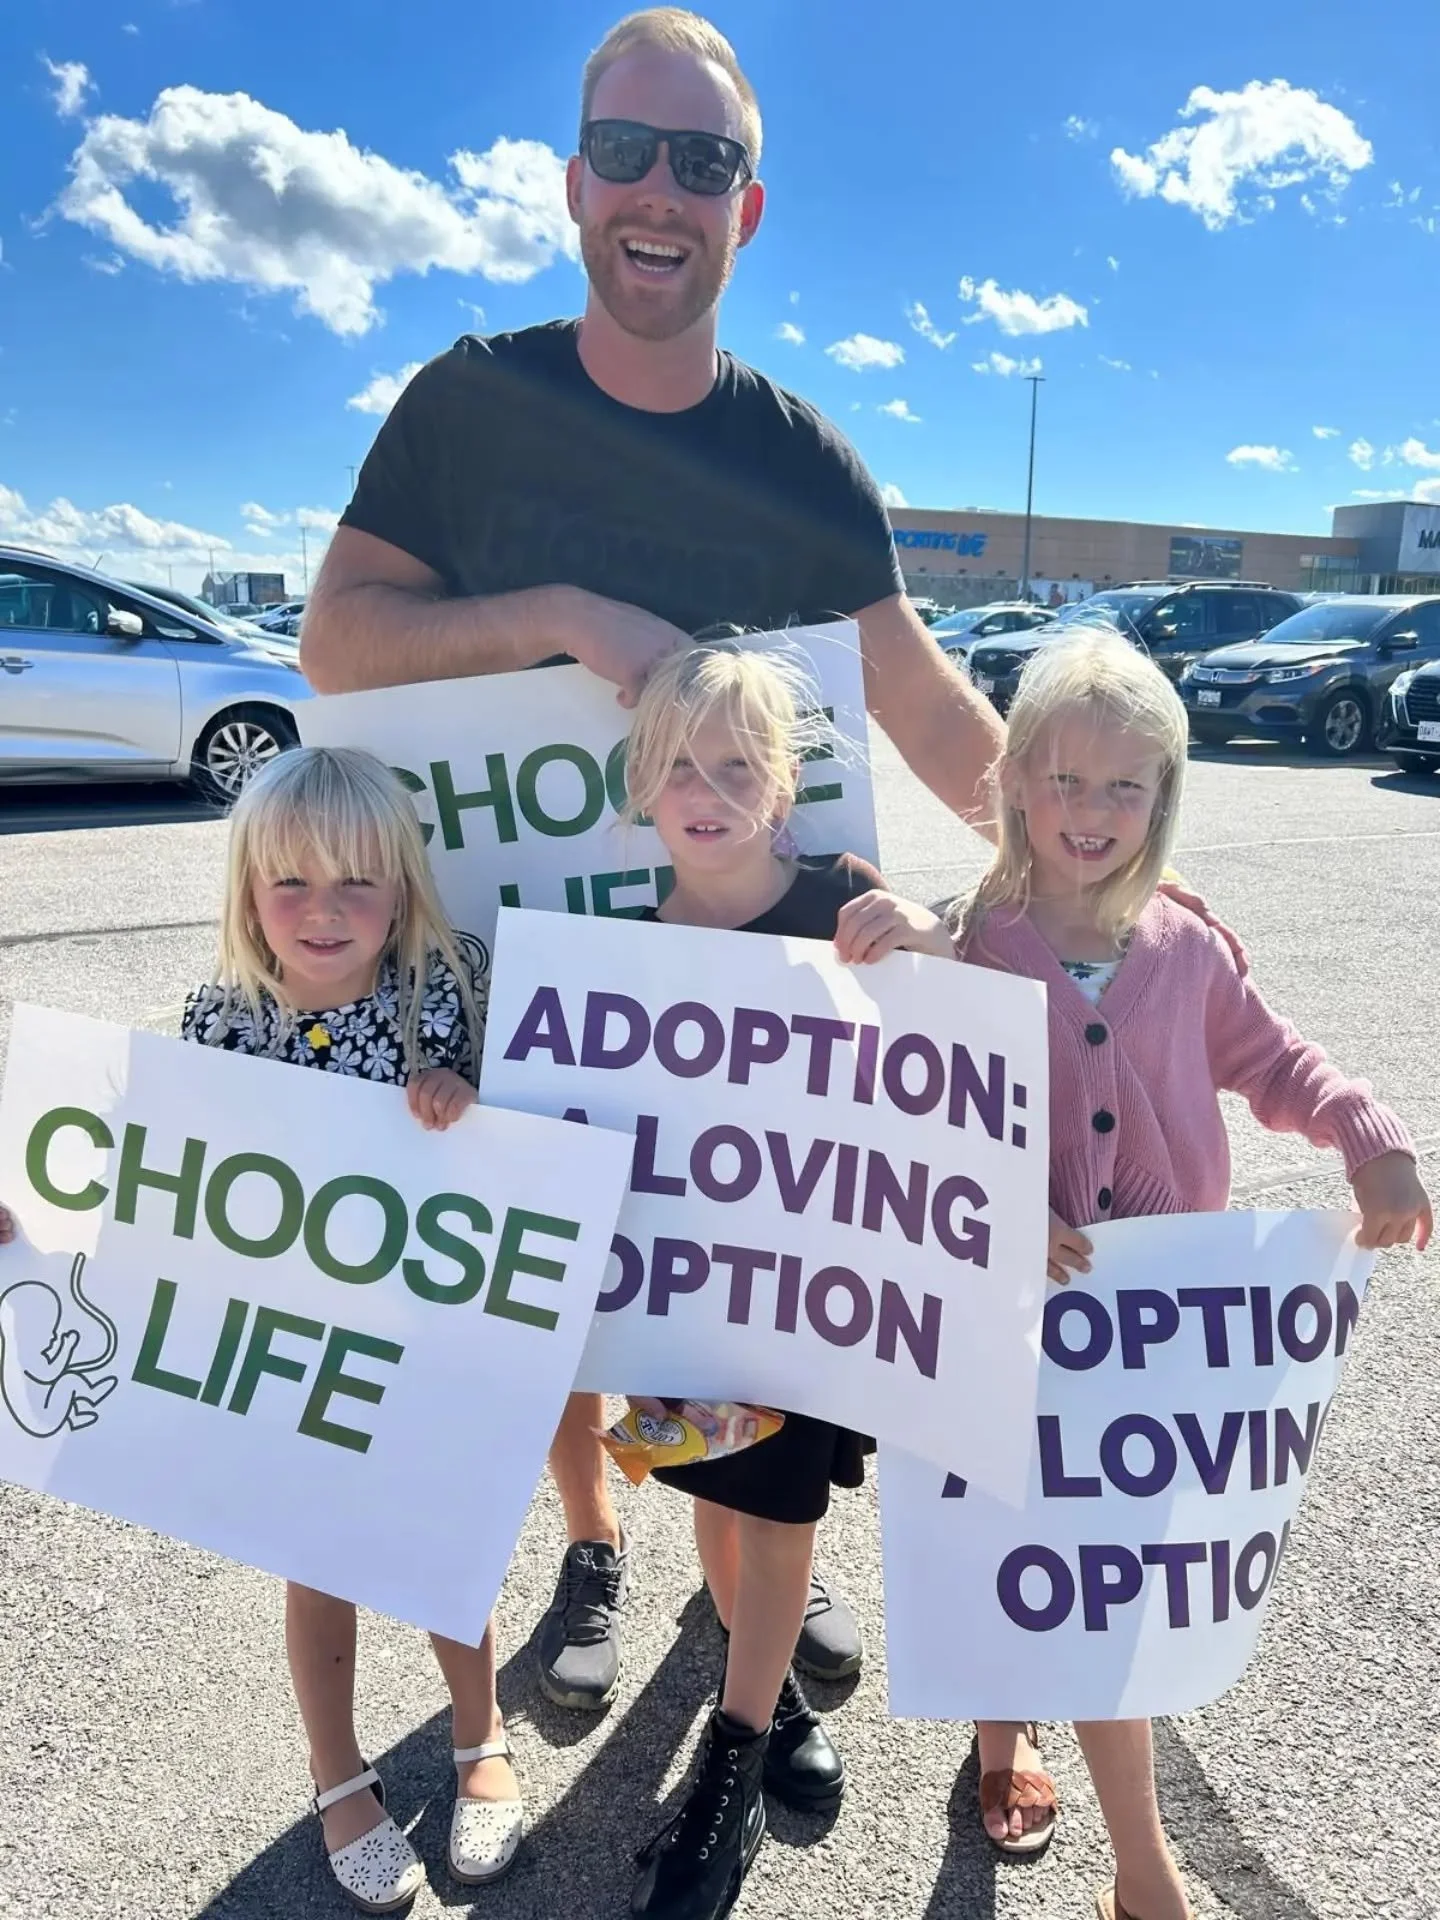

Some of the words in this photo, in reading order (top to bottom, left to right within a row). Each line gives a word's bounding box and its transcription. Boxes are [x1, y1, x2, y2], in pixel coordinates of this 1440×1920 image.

[893, 529, 959, 551] PORTING
[503, 985, 1028, 1149] ADOPTION:
[25, 1106, 581, 1332] CHOOSE
[630, 1115, 992, 1269] LOVING
[131, 1278, 405, 1455] LIFE
[1037, 1401, 1332, 1498] LOVIN
[997, 1519, 1291, 1632] OPTIO
